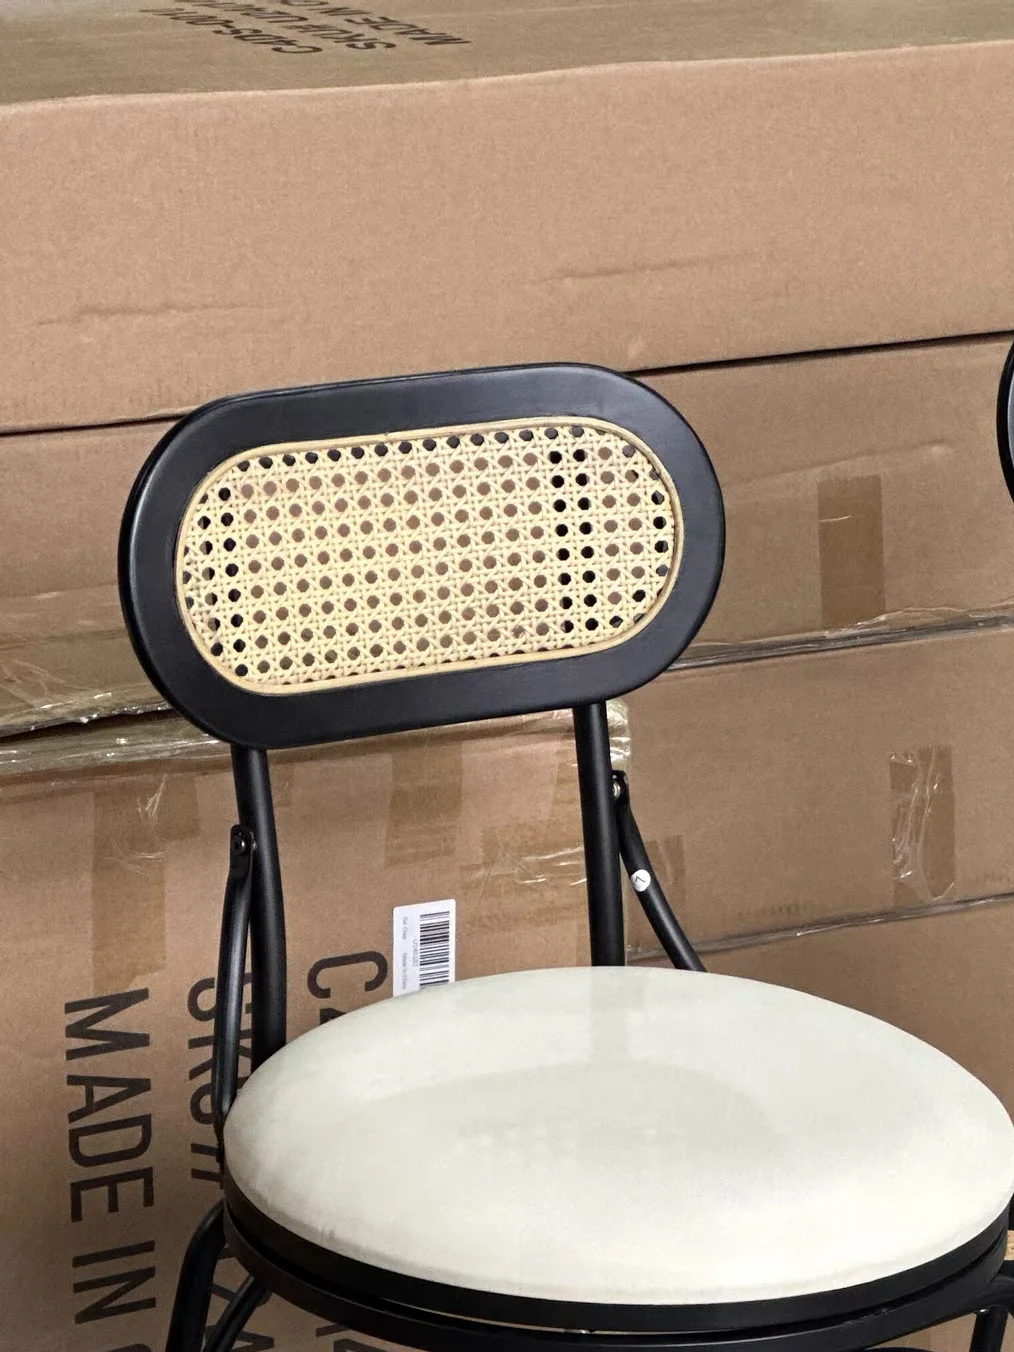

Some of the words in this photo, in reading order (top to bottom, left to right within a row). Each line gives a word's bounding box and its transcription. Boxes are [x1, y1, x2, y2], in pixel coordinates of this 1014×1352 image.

[345, 16, 472, 46] MADE
[64, 988, 155, 1223] MADE
[72, 1240, 157, 1325] IN
